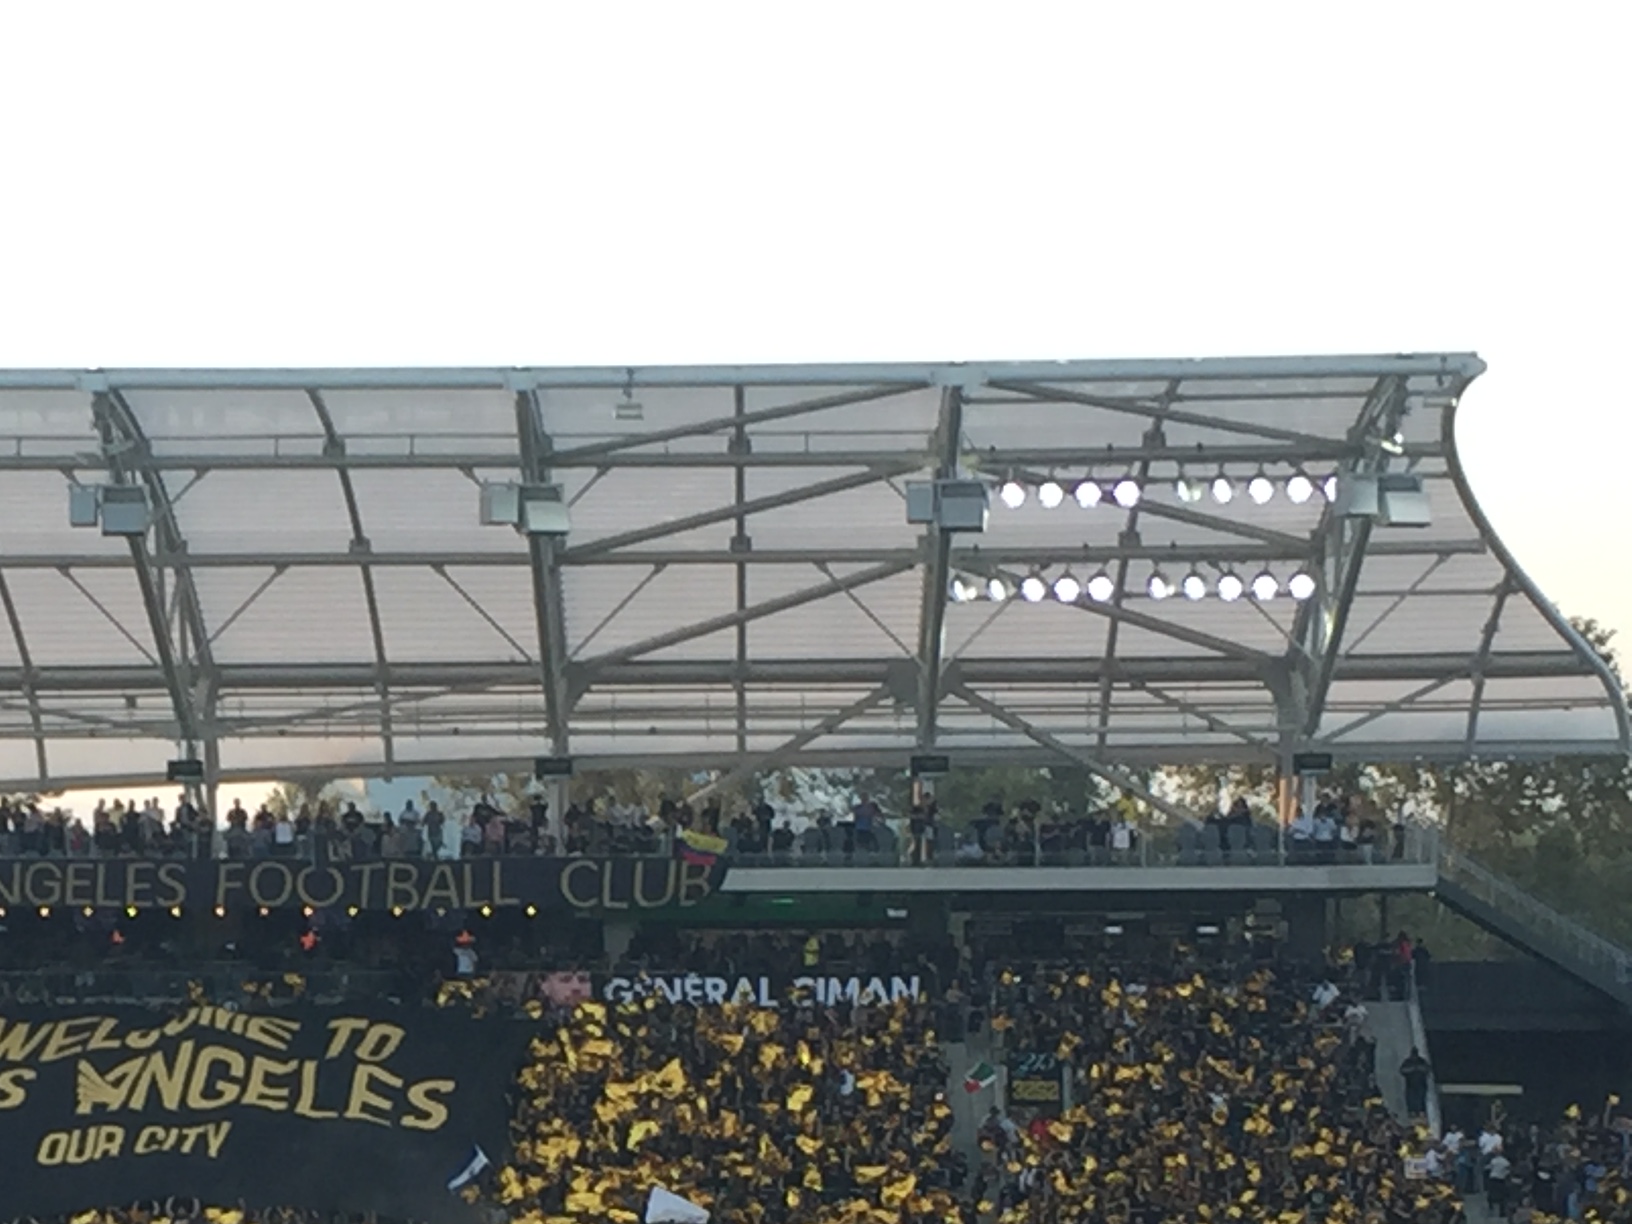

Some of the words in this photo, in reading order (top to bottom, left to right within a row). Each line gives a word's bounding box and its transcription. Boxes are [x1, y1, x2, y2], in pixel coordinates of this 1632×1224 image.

[217, 861, 520, 910] FOOTBALL
[559, 860, 712, 908] CLUB
[325, 1018, 406, 1061] TO
[76, 1040, 456, 1129] ANGELES
[37, 1122, 125, 1165] OUR
[134, 1121, 232, 1158] CITY
